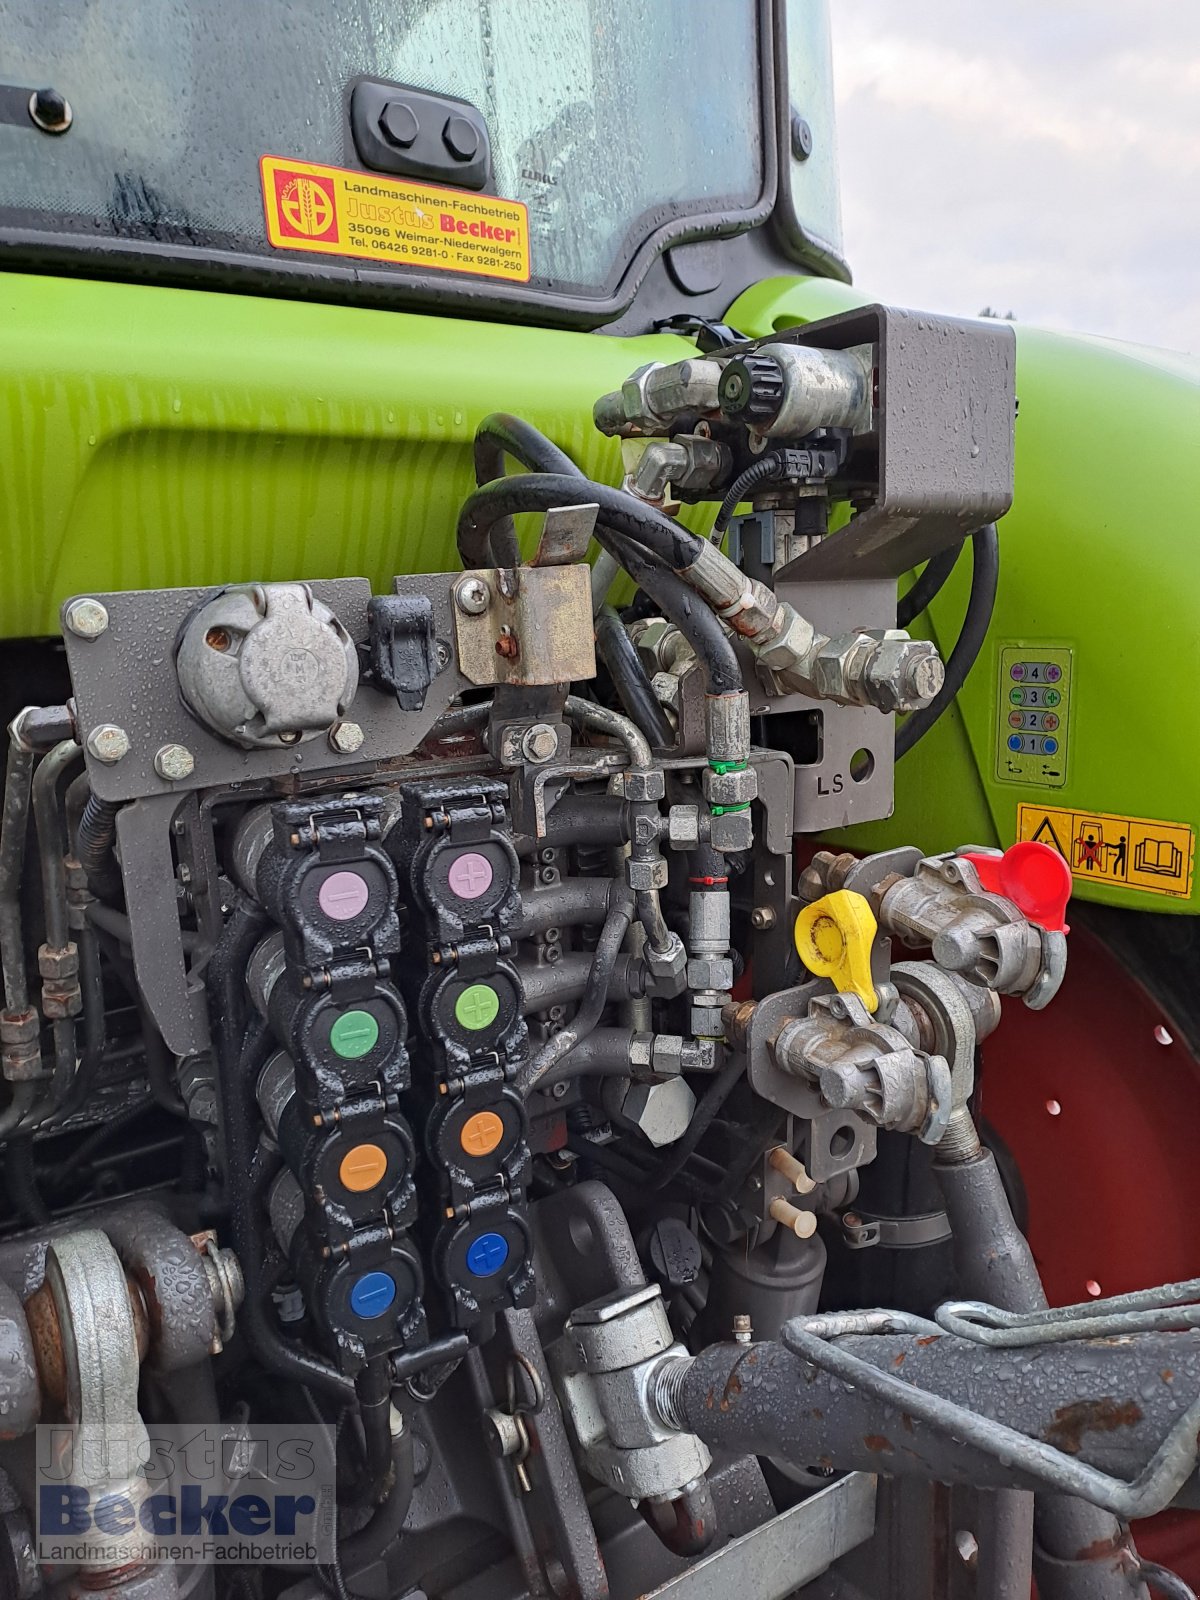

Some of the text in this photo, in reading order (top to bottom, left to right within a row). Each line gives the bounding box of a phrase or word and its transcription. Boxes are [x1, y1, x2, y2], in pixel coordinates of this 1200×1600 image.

[344, 180, 520, 221] Landmaschinen-Fachbetrieb
[346, 197, 434, 230] Justus
[440, 213, 516, 243] Becker
[348, 222, 390, 237] 35096
[395, 229, 522, 259] Weimar-Niederwalgern
[348, 235, 369, 248] Tel.
[371, 239, 409, 254] 06426
[411, 245, 448, 259] 9281-0
[456, 252, 475, 263] Fax
[477, 256, 522, 272] 9281-250
[1031, 667, 1039, 679] 4
[1030, 691, 1038, 703] 3
[1029, 714, 1037, 726] 2
[1029, 739, 1036, 751] 1
[817, 773, 844, 795] LS
